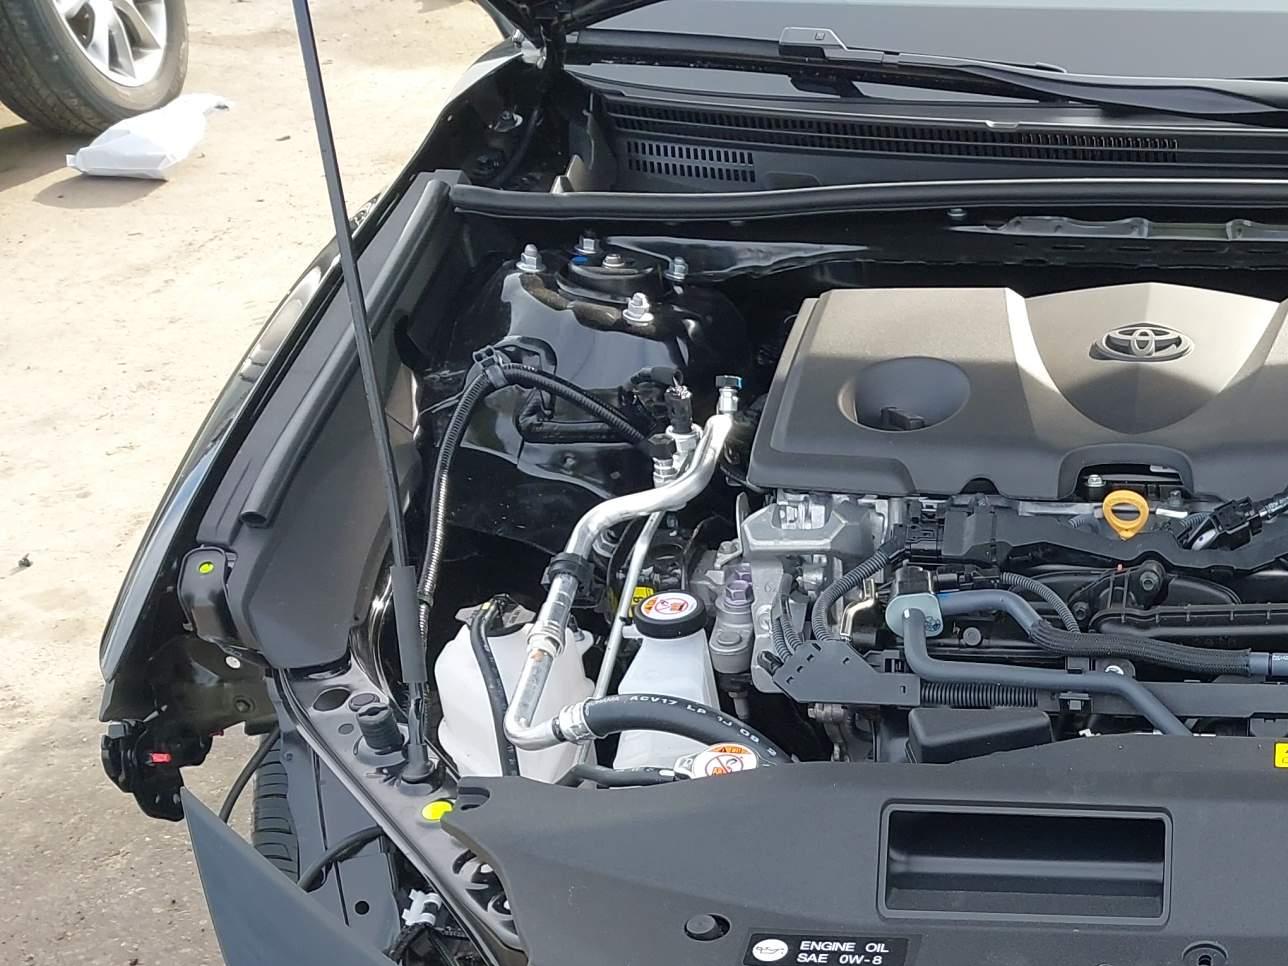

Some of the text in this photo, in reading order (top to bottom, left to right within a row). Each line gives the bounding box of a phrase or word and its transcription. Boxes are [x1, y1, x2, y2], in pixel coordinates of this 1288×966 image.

[629, 696, 678, 705] ACV17
[800, 941, 889, 953] ENGINE OIL
[797, 953, 882, 965] SAE 0W-8
